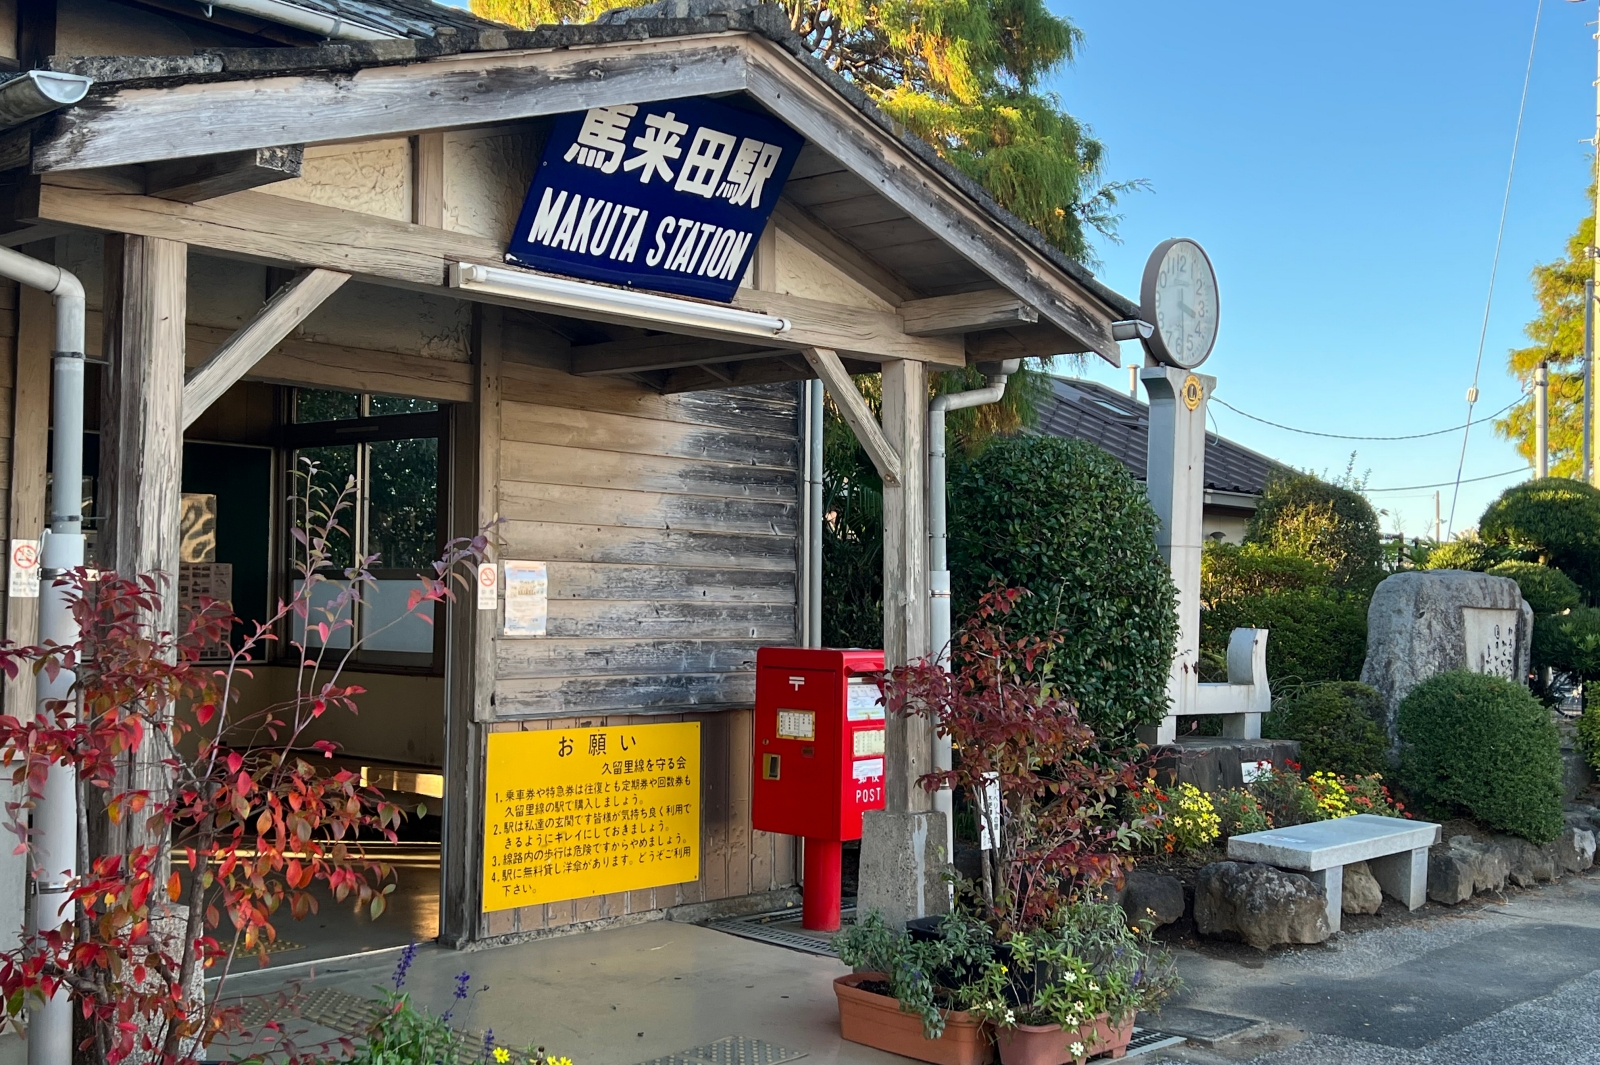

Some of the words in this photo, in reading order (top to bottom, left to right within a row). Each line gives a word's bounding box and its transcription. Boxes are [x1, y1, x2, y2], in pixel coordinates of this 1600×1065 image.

[563, 103, 783, 209] 馬来田駅
[528, 187, 648, 263] MAKUTA
[646, 216, 752, 281] STATION
[601, 755, 687, 775] 久留里線を守る会
[856, 787, 881, 804] POST
[502, 884, 537, 897] 下さい。
